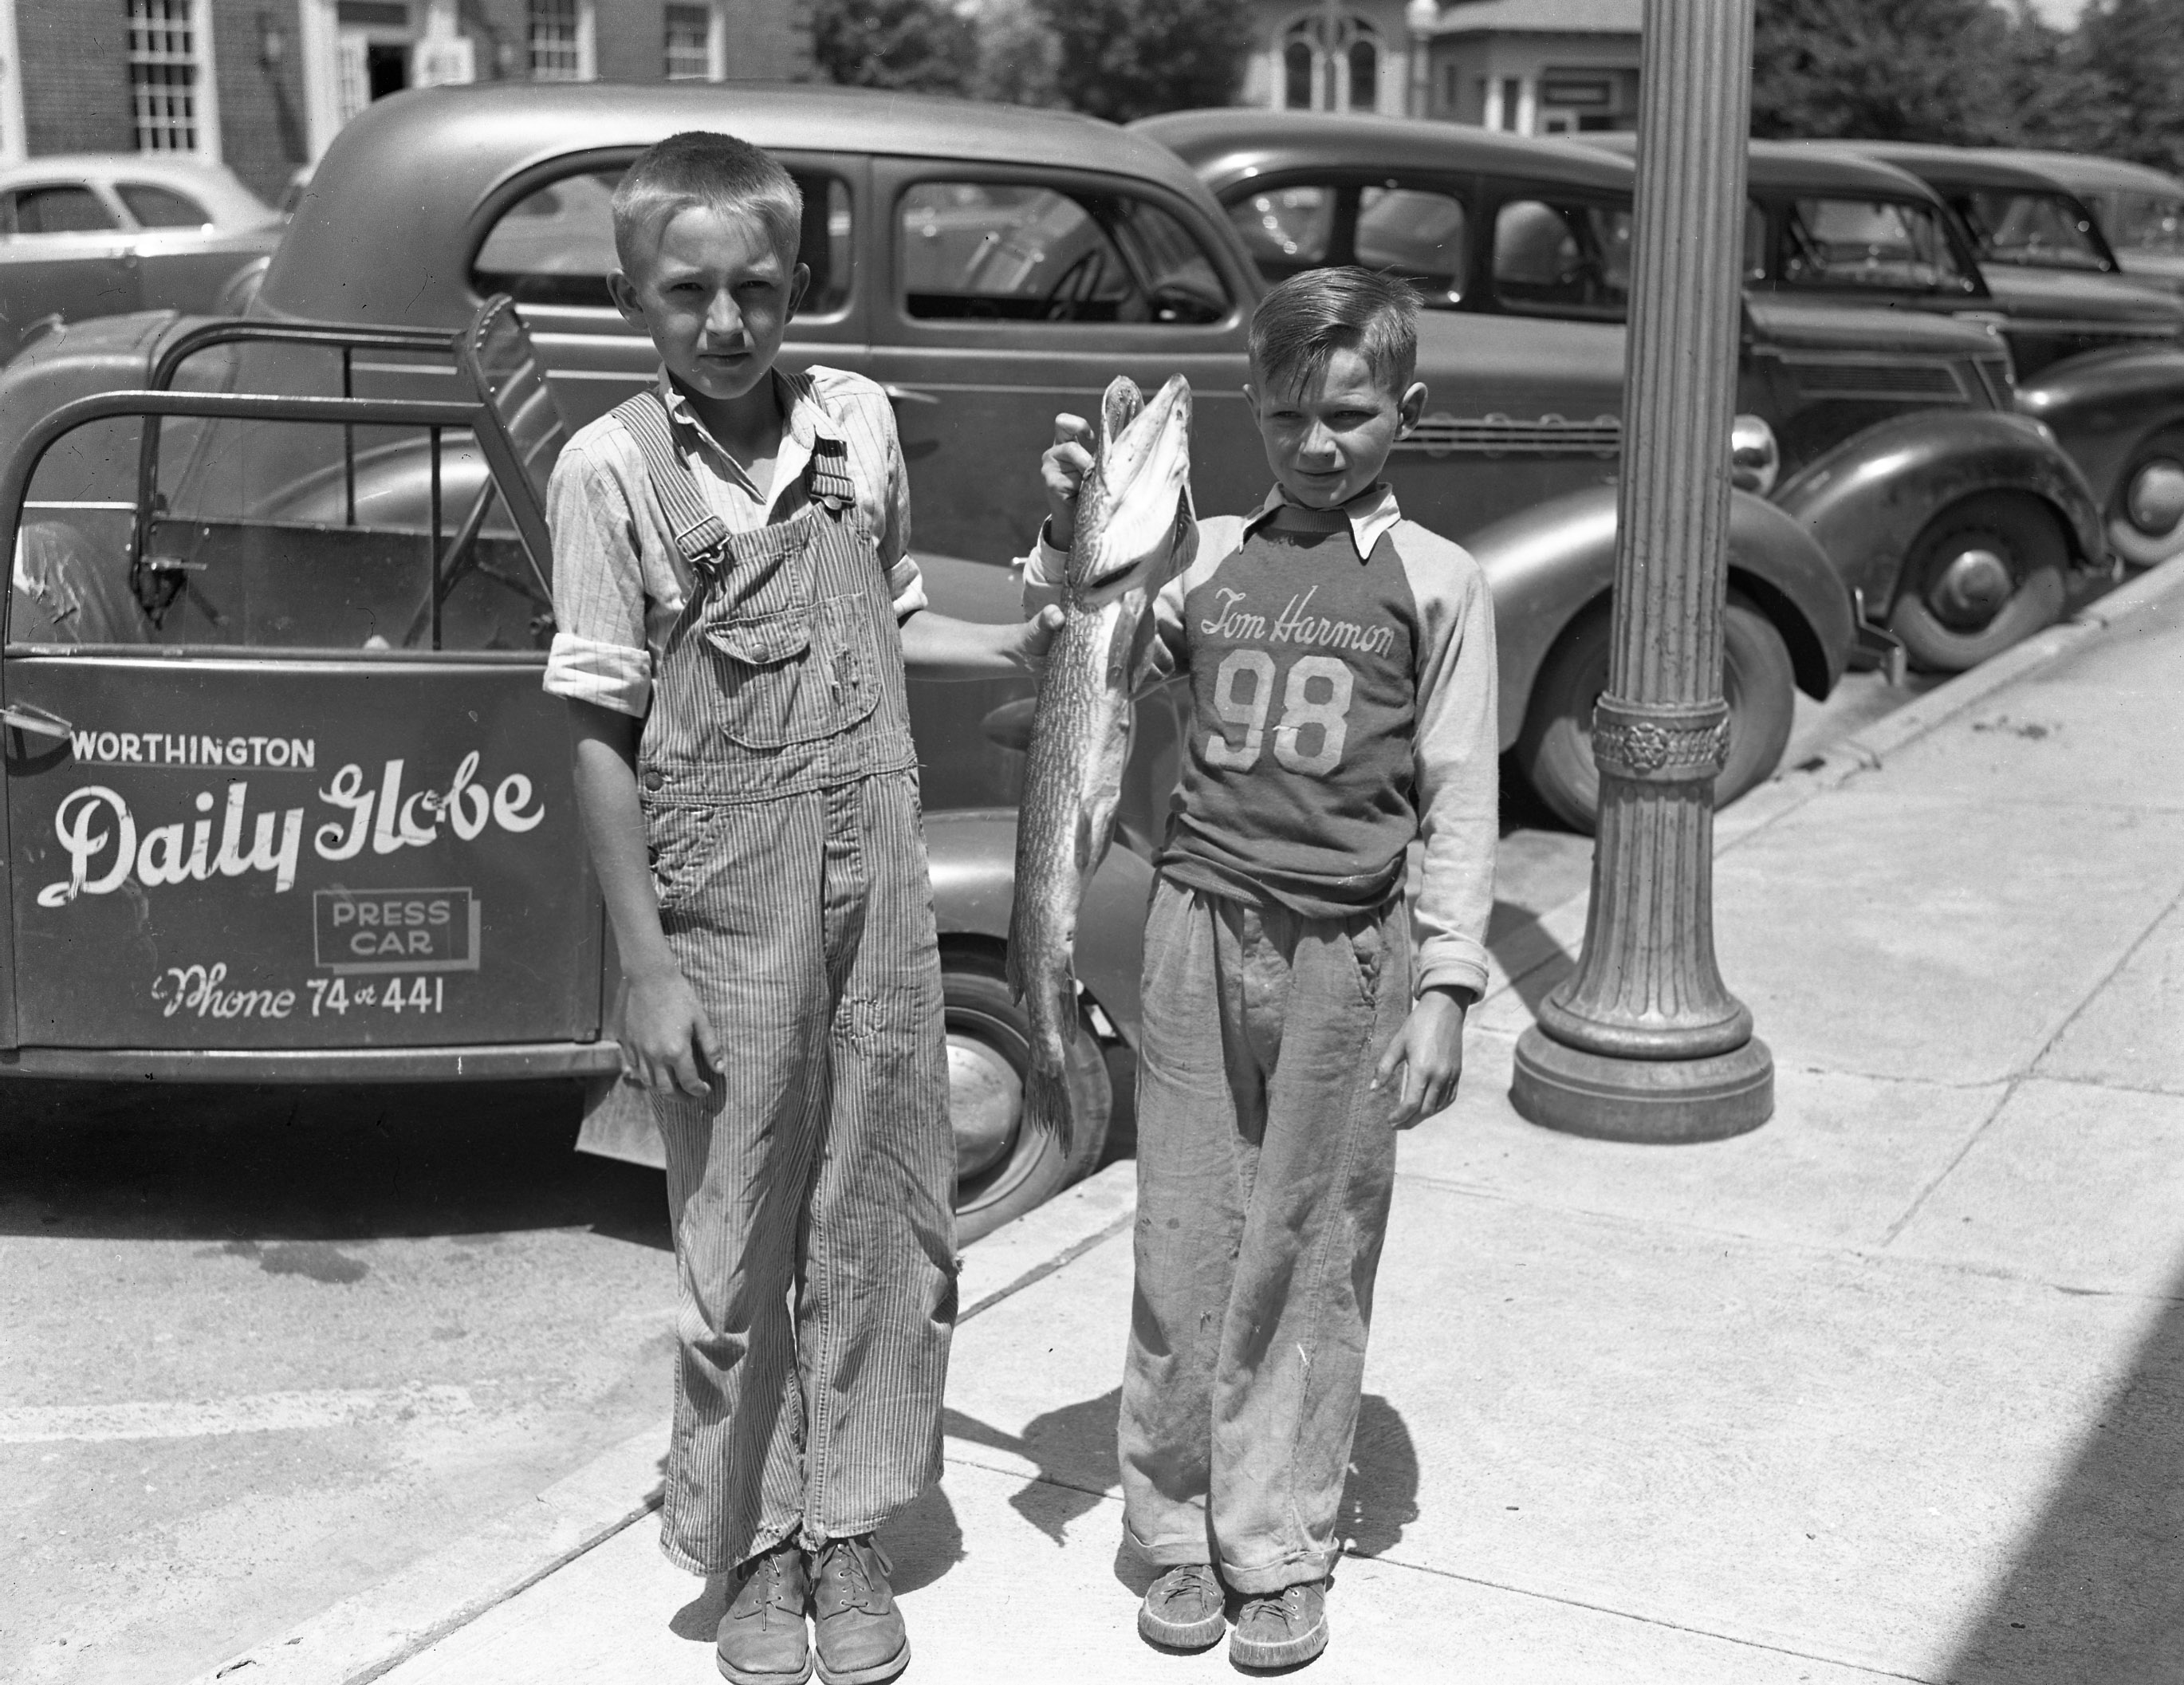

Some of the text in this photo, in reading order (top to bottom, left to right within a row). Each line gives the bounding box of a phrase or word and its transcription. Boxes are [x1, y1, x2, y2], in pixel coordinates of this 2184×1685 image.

[1201, 585, 1395, 657] Tom Harmon
[1205, 648, 1355, 778] 98
[70, 730, 316, 768] WORTHINGTON
[37, 750, 545, 907] Daily Globe
[333, 901, 451, 927] PRESS
[349, 930, 434, 955] CAR
[152, 962, 443, 1019] Phone 74 or 441
